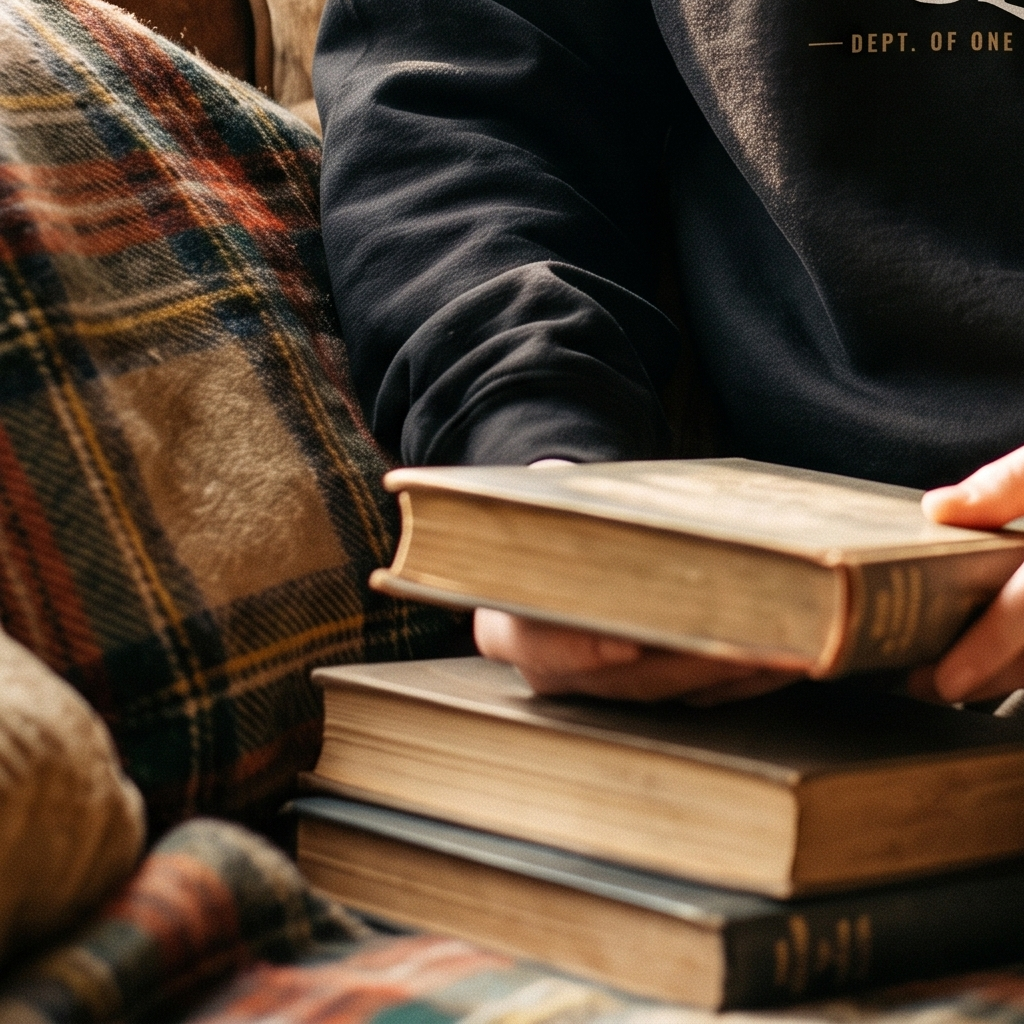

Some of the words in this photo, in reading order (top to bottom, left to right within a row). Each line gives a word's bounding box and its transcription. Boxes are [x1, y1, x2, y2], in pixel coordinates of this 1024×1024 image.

[851, 32, 916, 53] DEPT.
[930, 31, 957, 51] OF
[971, 31, 1013, 51] ONE
